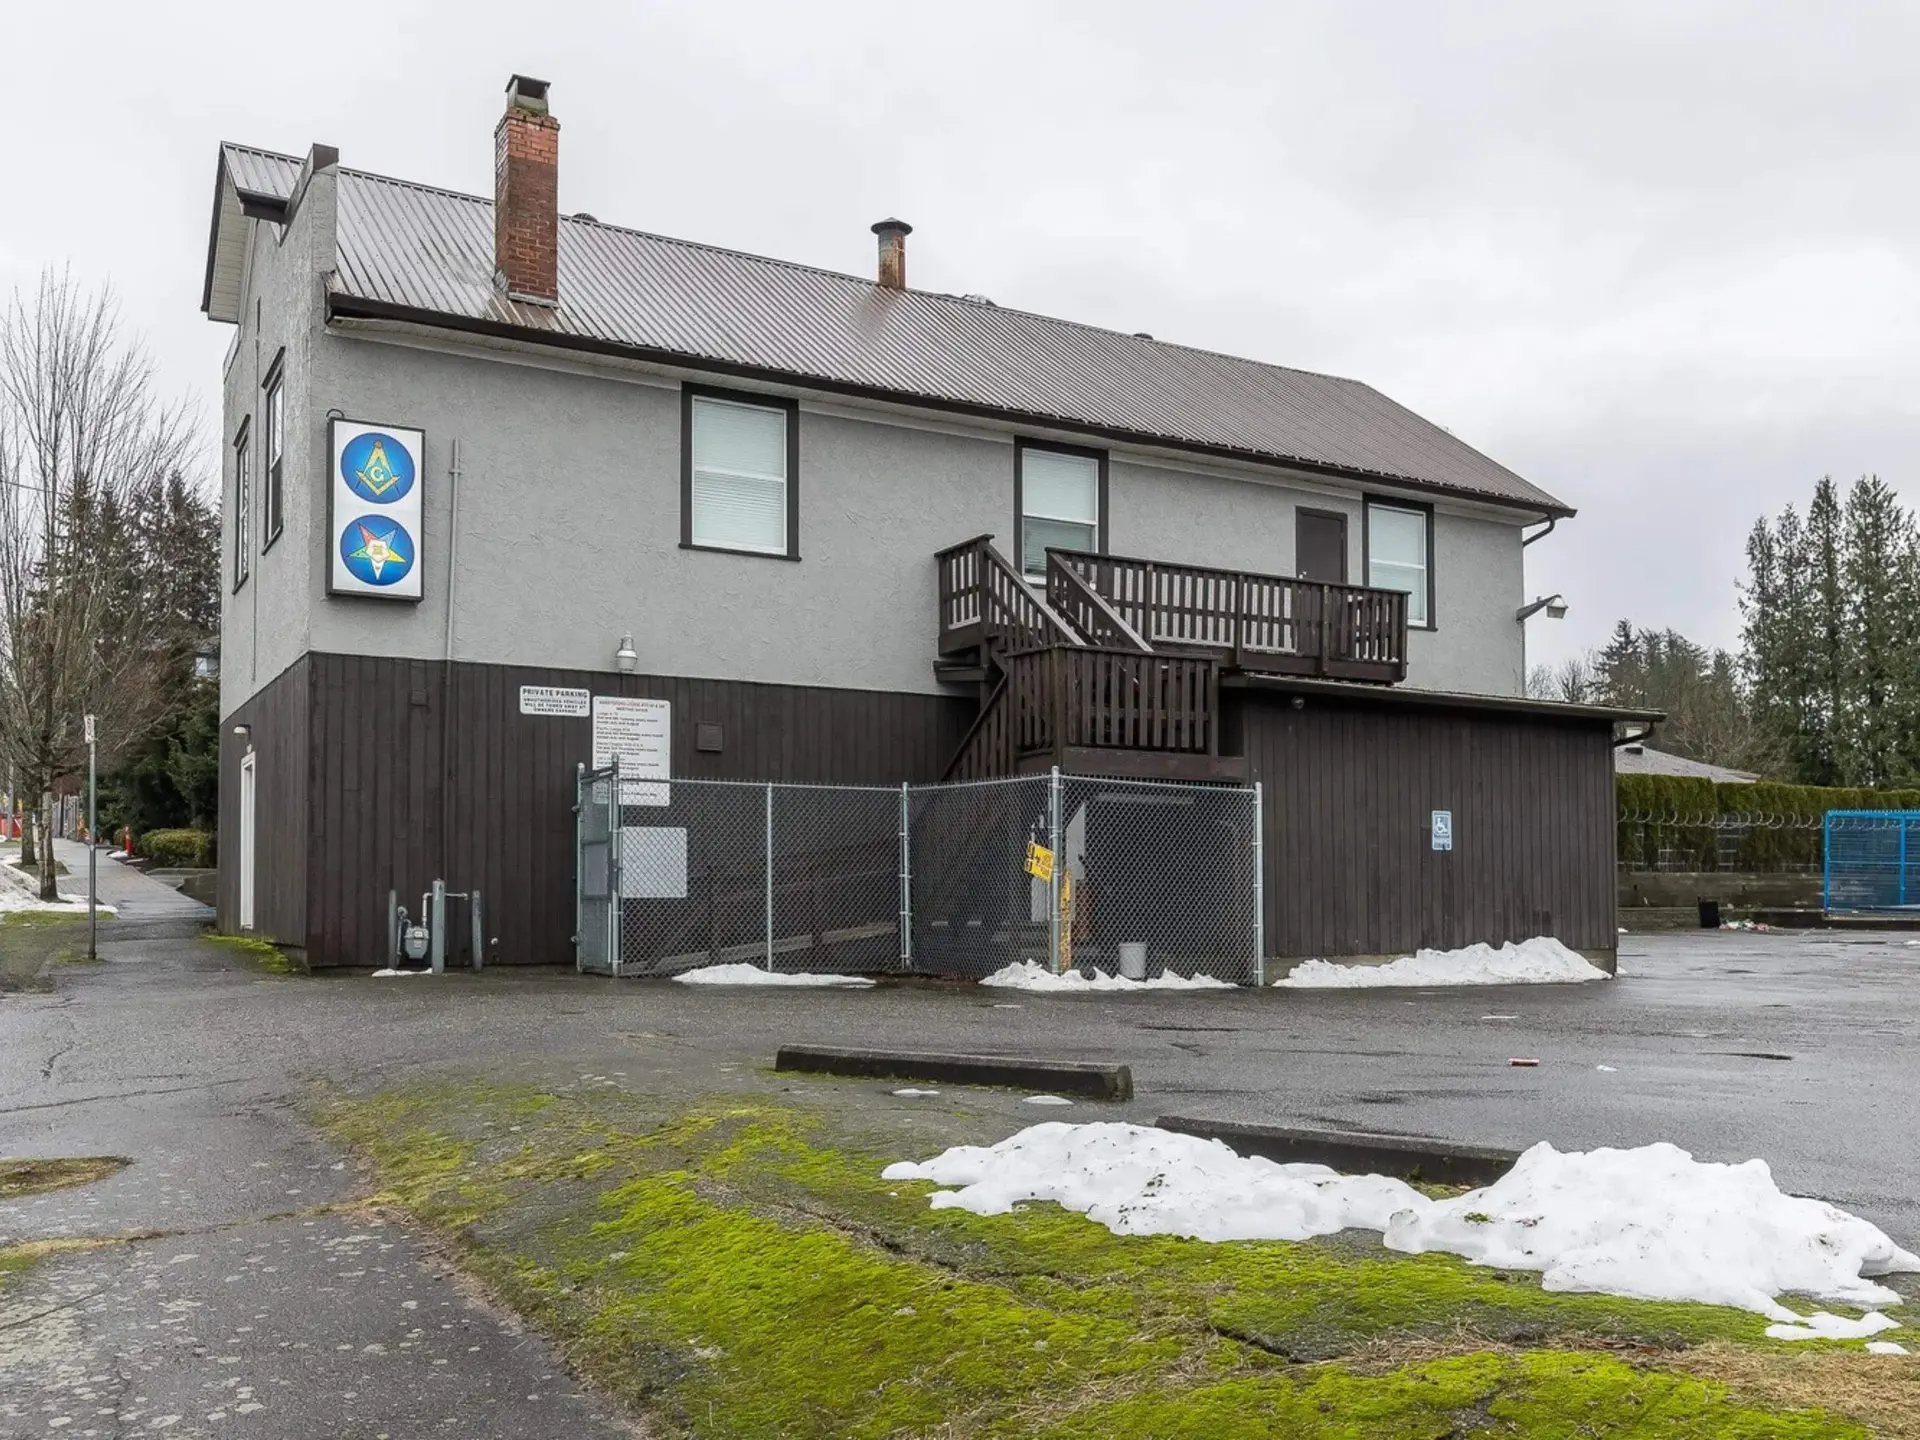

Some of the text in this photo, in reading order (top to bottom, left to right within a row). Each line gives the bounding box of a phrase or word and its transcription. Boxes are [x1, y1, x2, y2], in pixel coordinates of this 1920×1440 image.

[370, 467, 384, 481] G
[523, 688, 587, 698] PRIVATE PARKING
